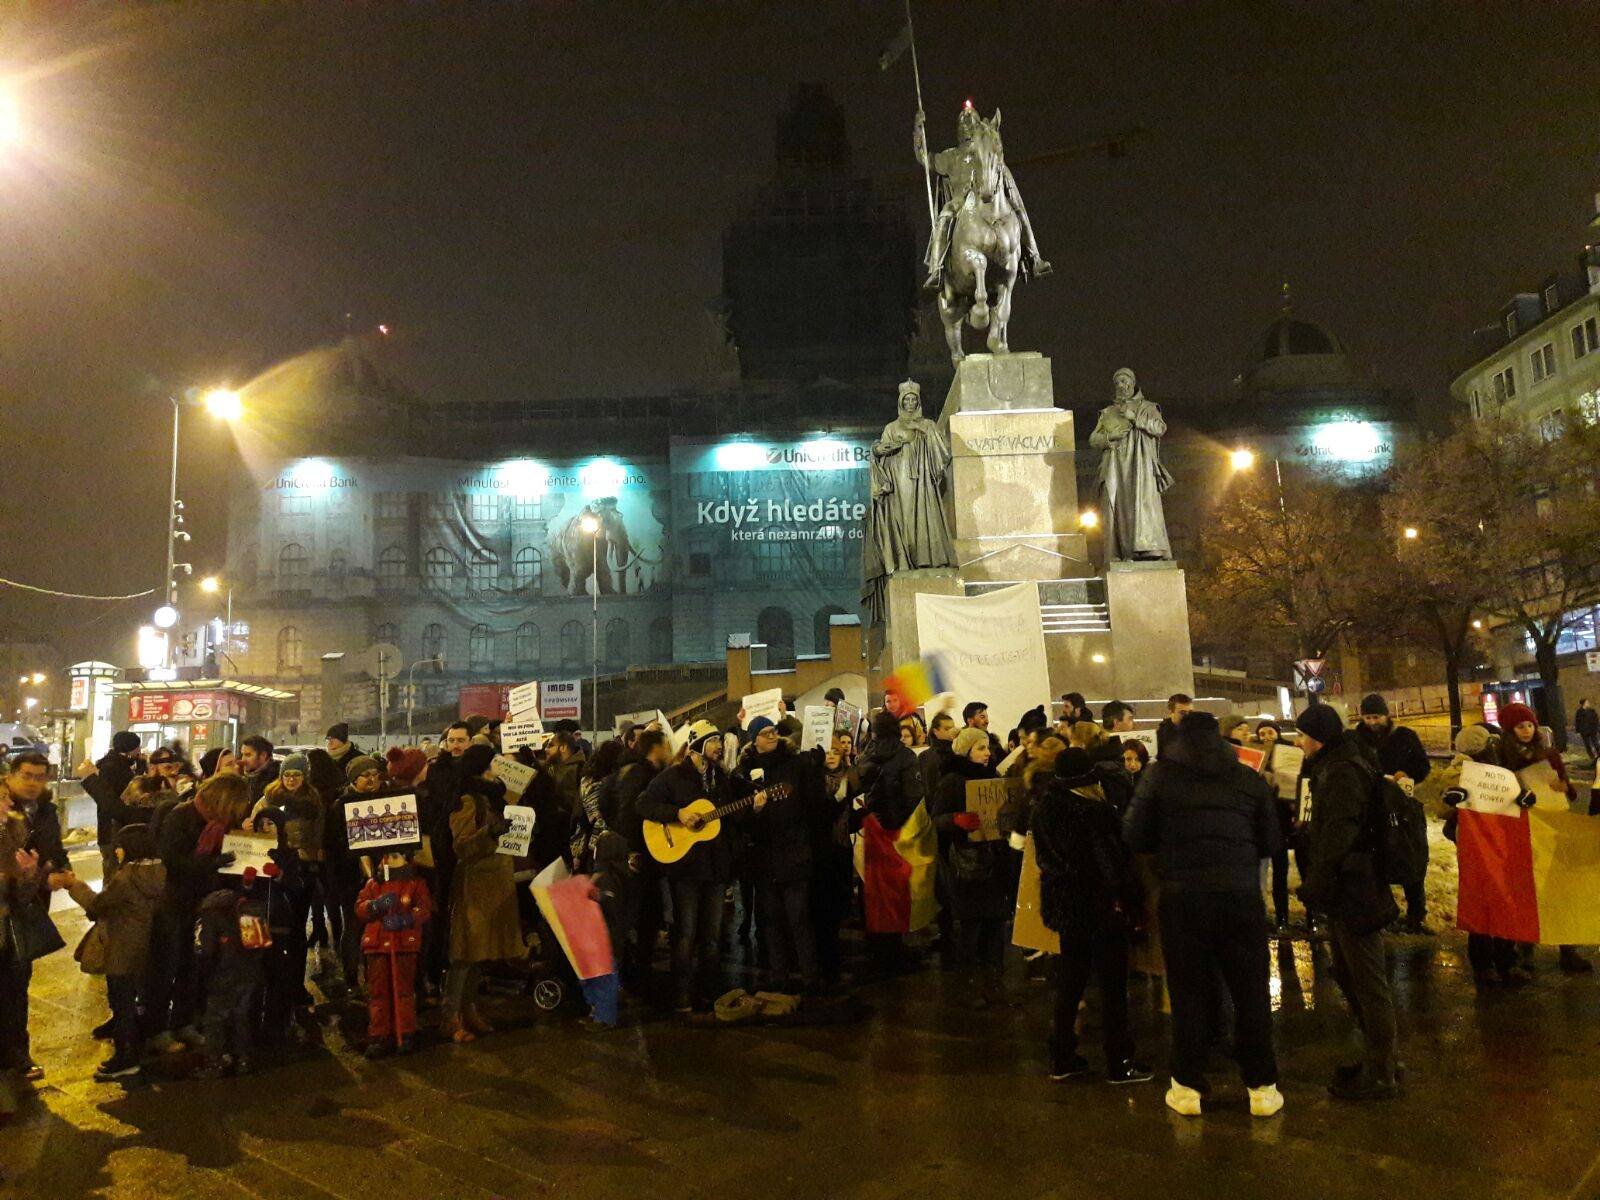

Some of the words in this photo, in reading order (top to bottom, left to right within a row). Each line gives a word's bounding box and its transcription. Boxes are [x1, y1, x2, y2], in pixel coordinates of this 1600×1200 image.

[784, 447, 850, 463] UniCdit
[854, 447, 870, 462] Ba
[276, 477, 326, 489] UniCt
[330, 476, 358, 488] Bank
[697, 497, 760, 528] Když
[768, 497, 866, 523] hledáte
[731, 528, 765, 541] která
[848, 527, 864, 539] do
[1484, 771, 1496, 780] NO
[1497, 772, 1506, 781] TO
[1477, 781, 1499, 793] ABUSE
[1479, 792, 1504, 803] POWER
